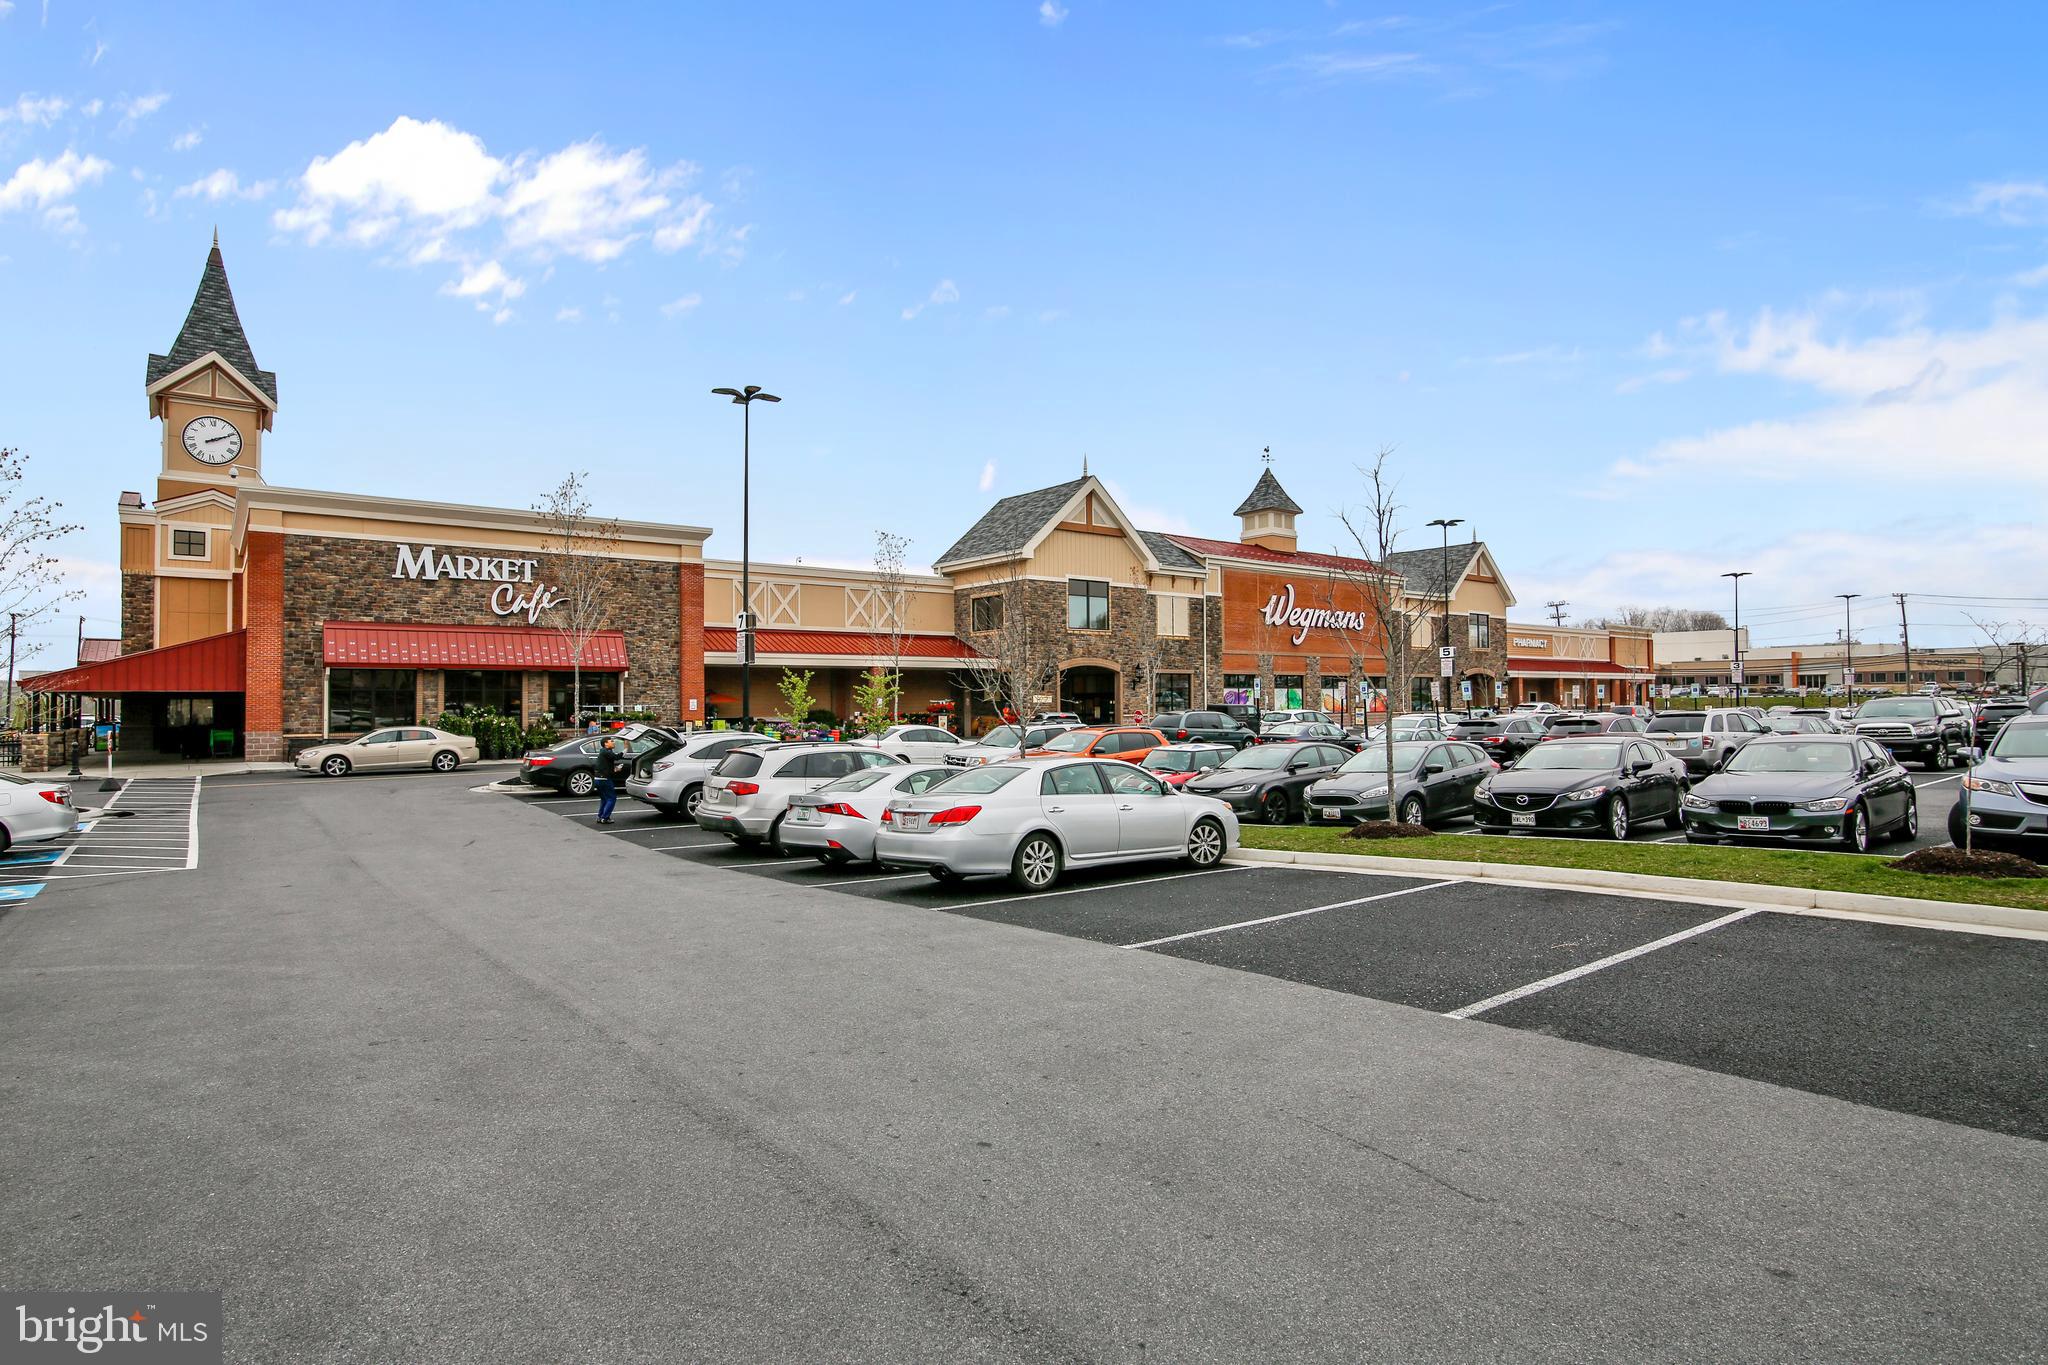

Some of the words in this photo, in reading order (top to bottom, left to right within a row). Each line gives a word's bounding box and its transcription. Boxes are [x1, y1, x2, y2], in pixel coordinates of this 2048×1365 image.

[391, 544, 538, 583] MARKET
[490, 583, 571, 625] Café
[1260, 583, 1366, 646] Wegmans
[1442, 648, 1451, 656] 5
